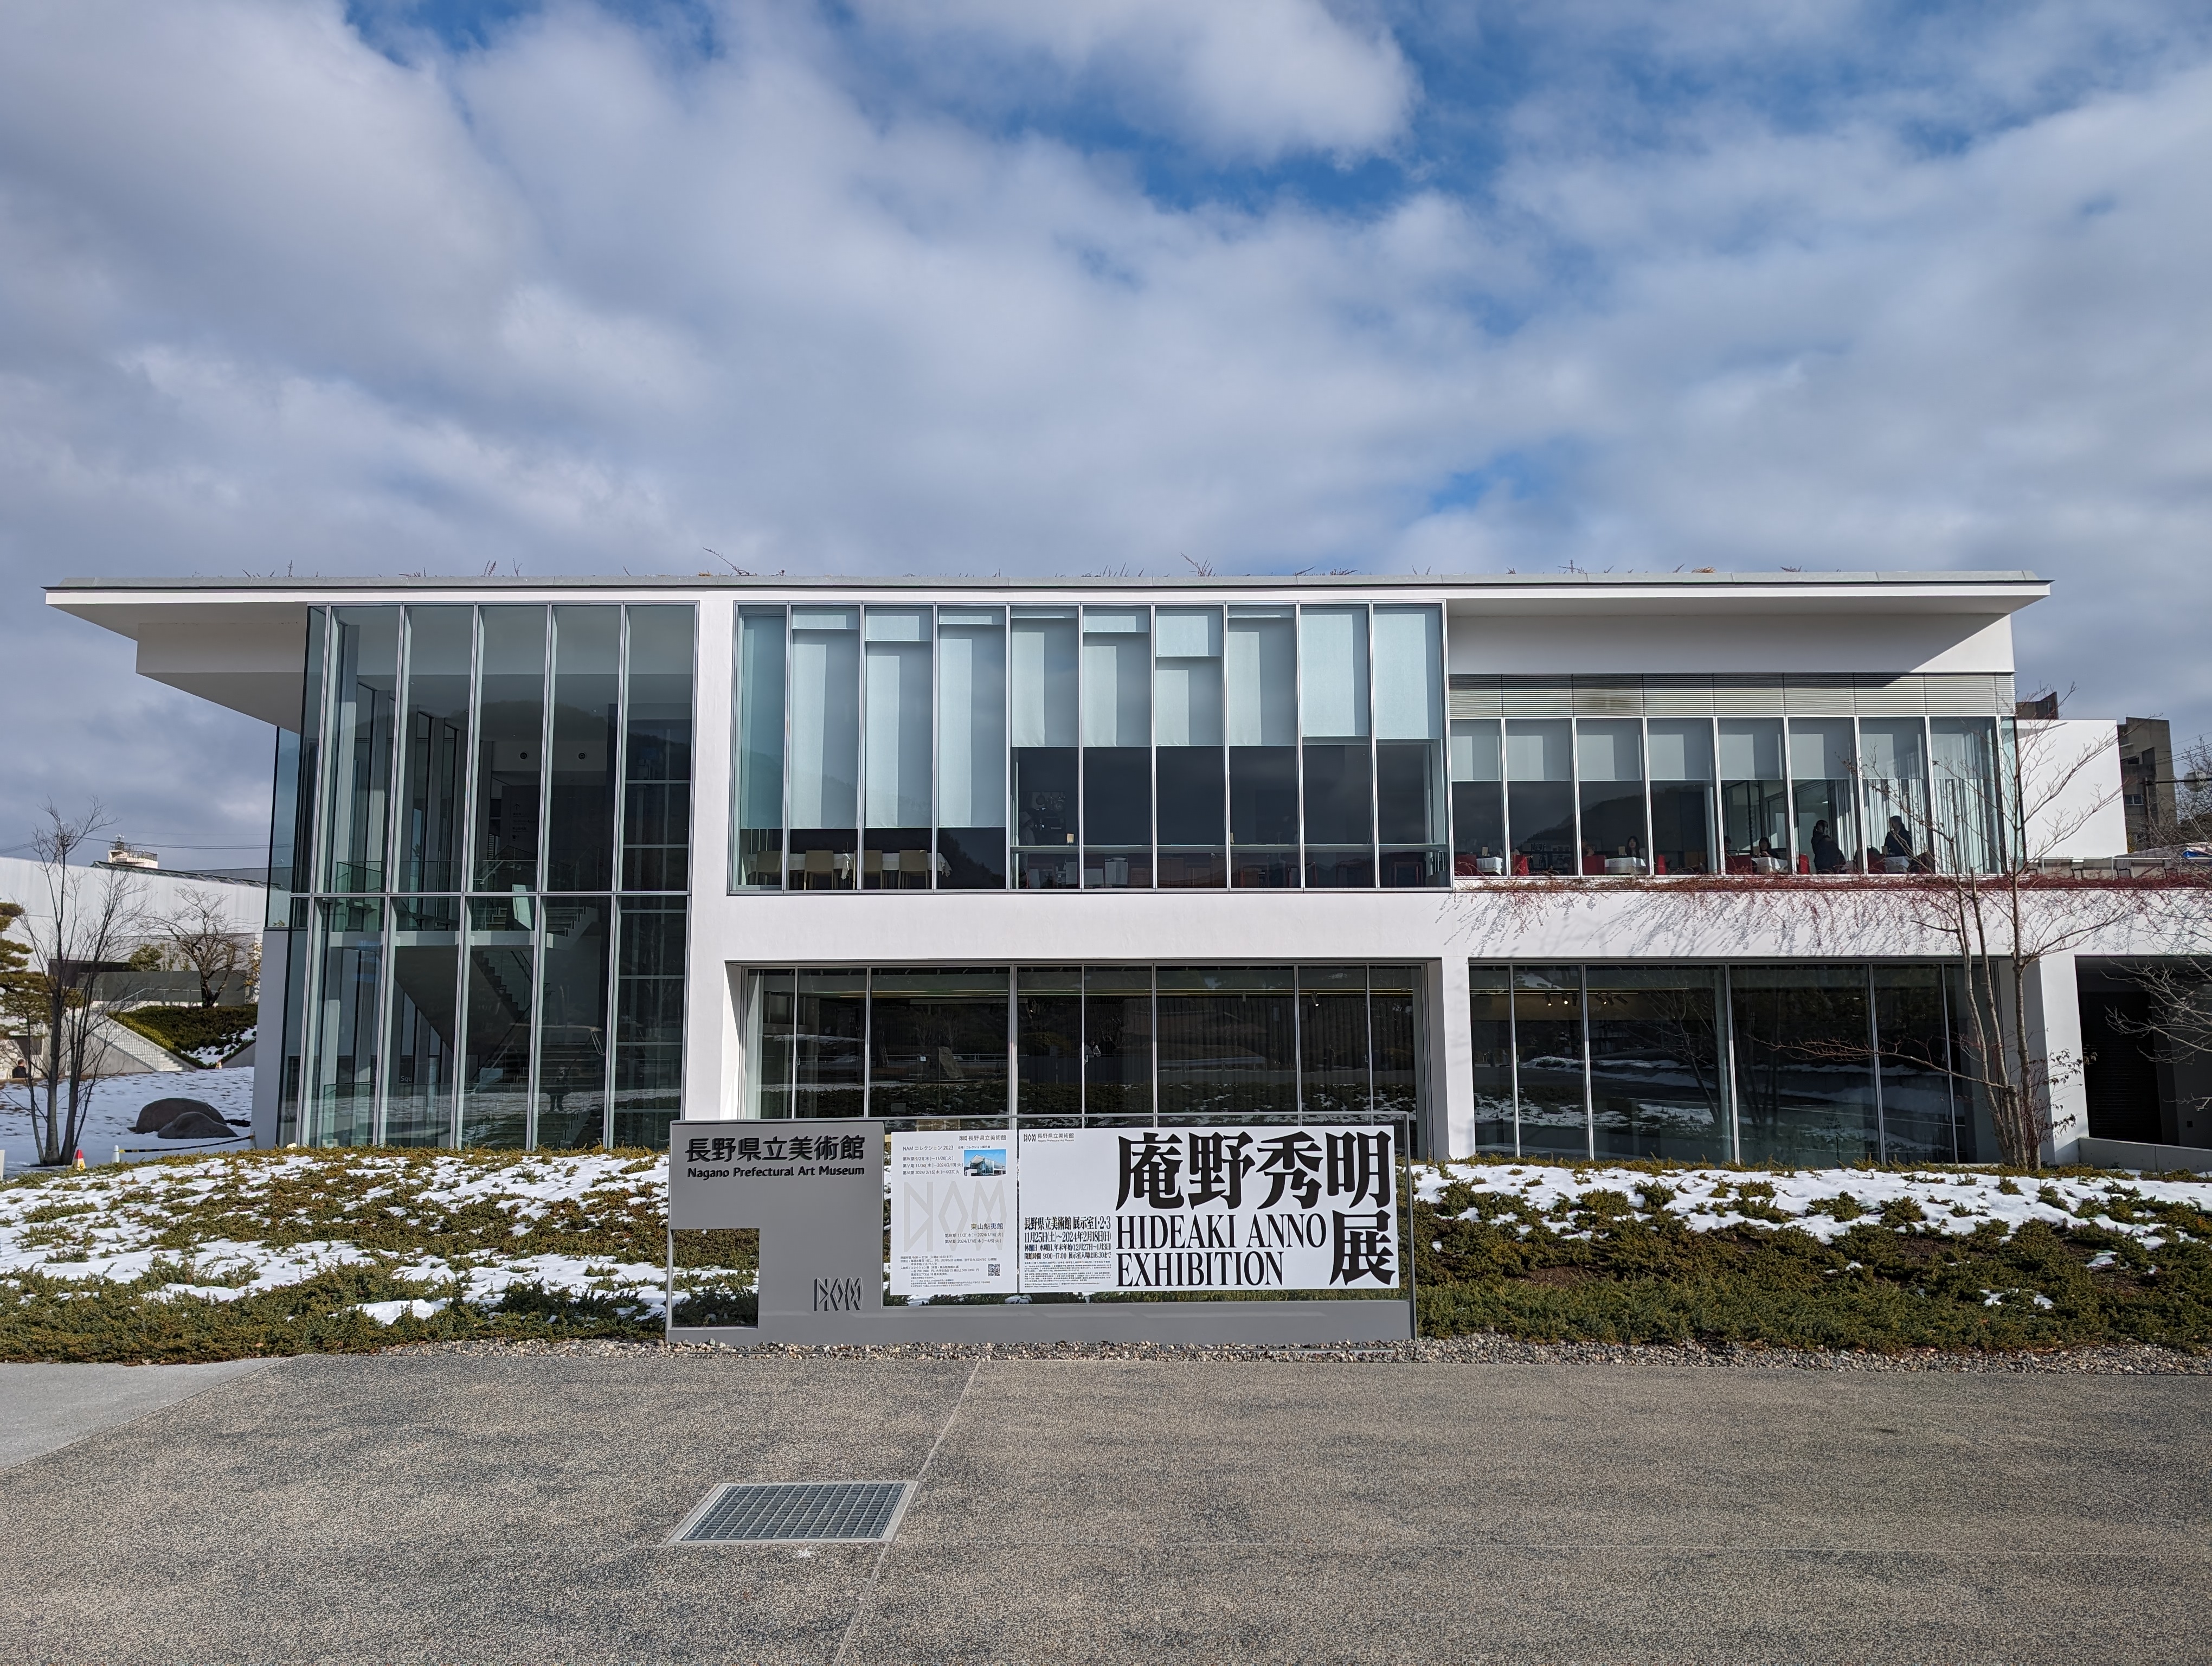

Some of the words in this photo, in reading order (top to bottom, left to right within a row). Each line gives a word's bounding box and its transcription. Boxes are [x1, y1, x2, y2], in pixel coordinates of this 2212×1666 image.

[685, 1135, 865, 1162] 長野県立美術館
[687, 1168, 729, 1180] Nagano
[734, 1167, 794, 1177] Prefectural
[798, 1166, 815, 1176] Art
[819, 1165, 864, 1175] Museum
[1115, 1130, 1392, 1211] 庵野秀明
[1024, 1216, 1071, 1231] 長野県立美術館
[1116, 1214, 1237, 1249] HIDEAKI
[1246, 1213, 1326, 1248] ANNO
[1329, 1209, 1396, 1285] 展
[1116, 1251, 1284, 1286] EXHIBITION
